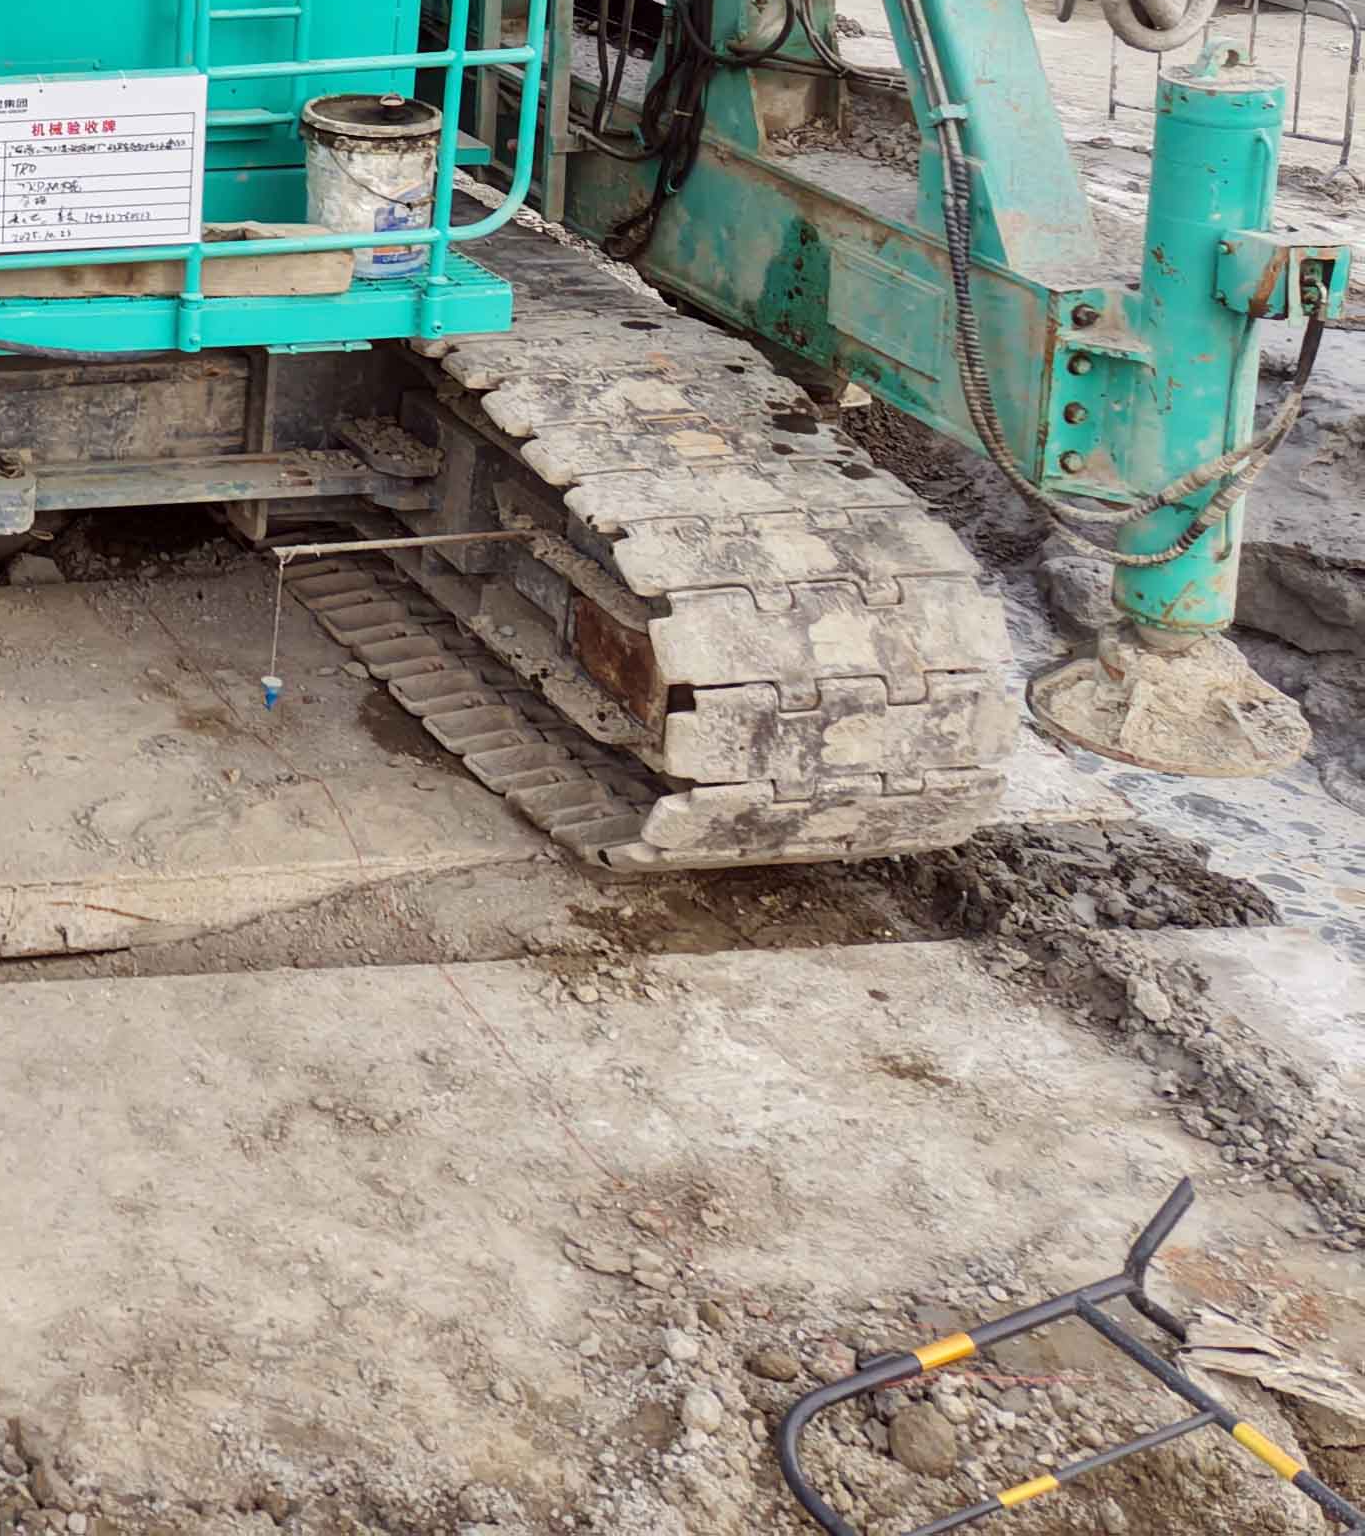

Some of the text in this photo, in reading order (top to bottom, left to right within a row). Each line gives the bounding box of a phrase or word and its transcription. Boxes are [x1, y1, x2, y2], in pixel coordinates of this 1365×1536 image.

[31, 120, 117, 137] 机械验收牌
